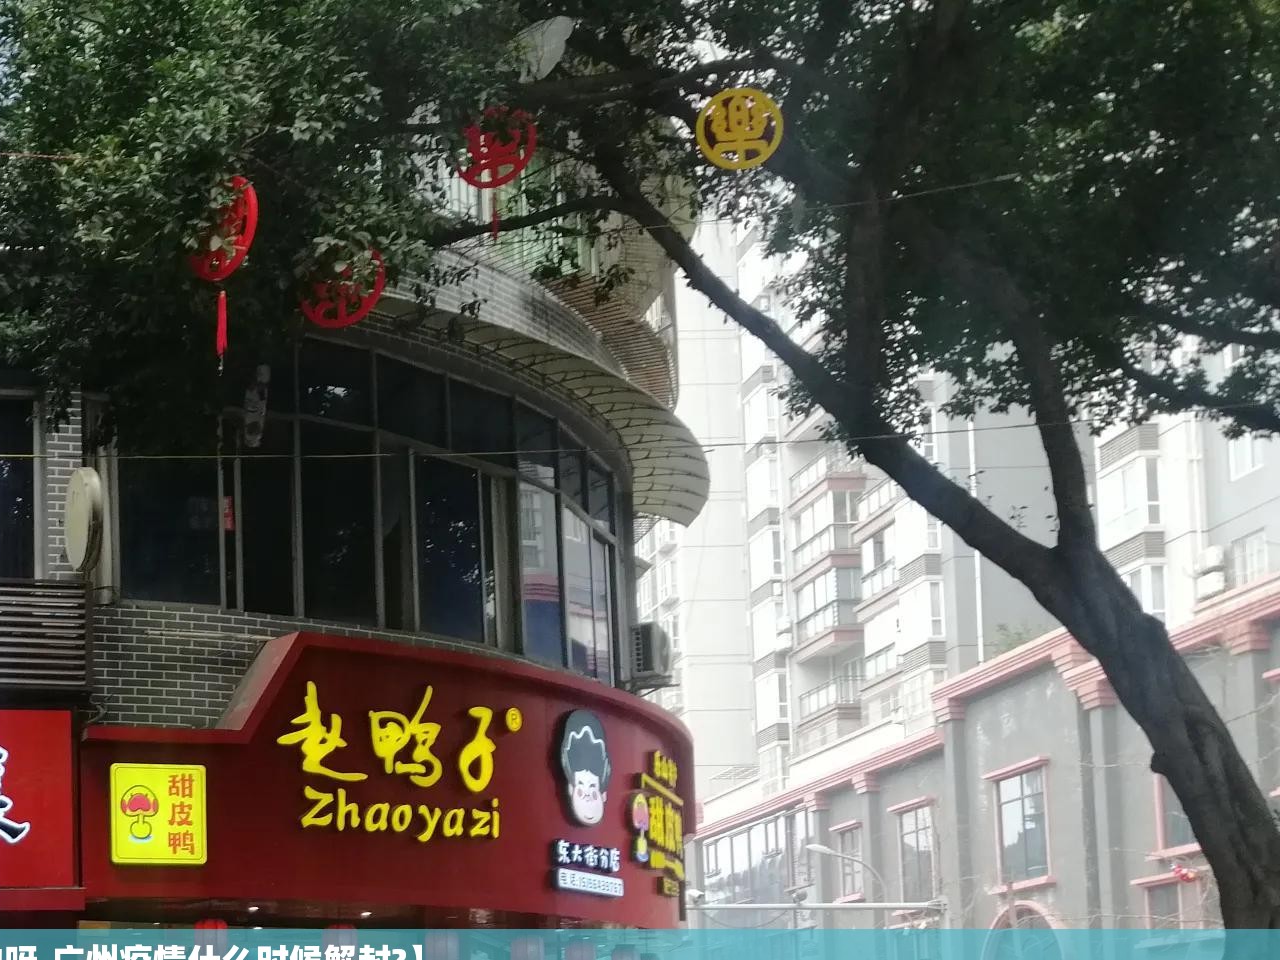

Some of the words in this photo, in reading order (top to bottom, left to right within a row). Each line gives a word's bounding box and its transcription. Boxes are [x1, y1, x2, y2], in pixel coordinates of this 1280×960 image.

[168, 773, 195, 855] 甜皮鸭
[300, 787, 500, 842] Zhaoyazi
